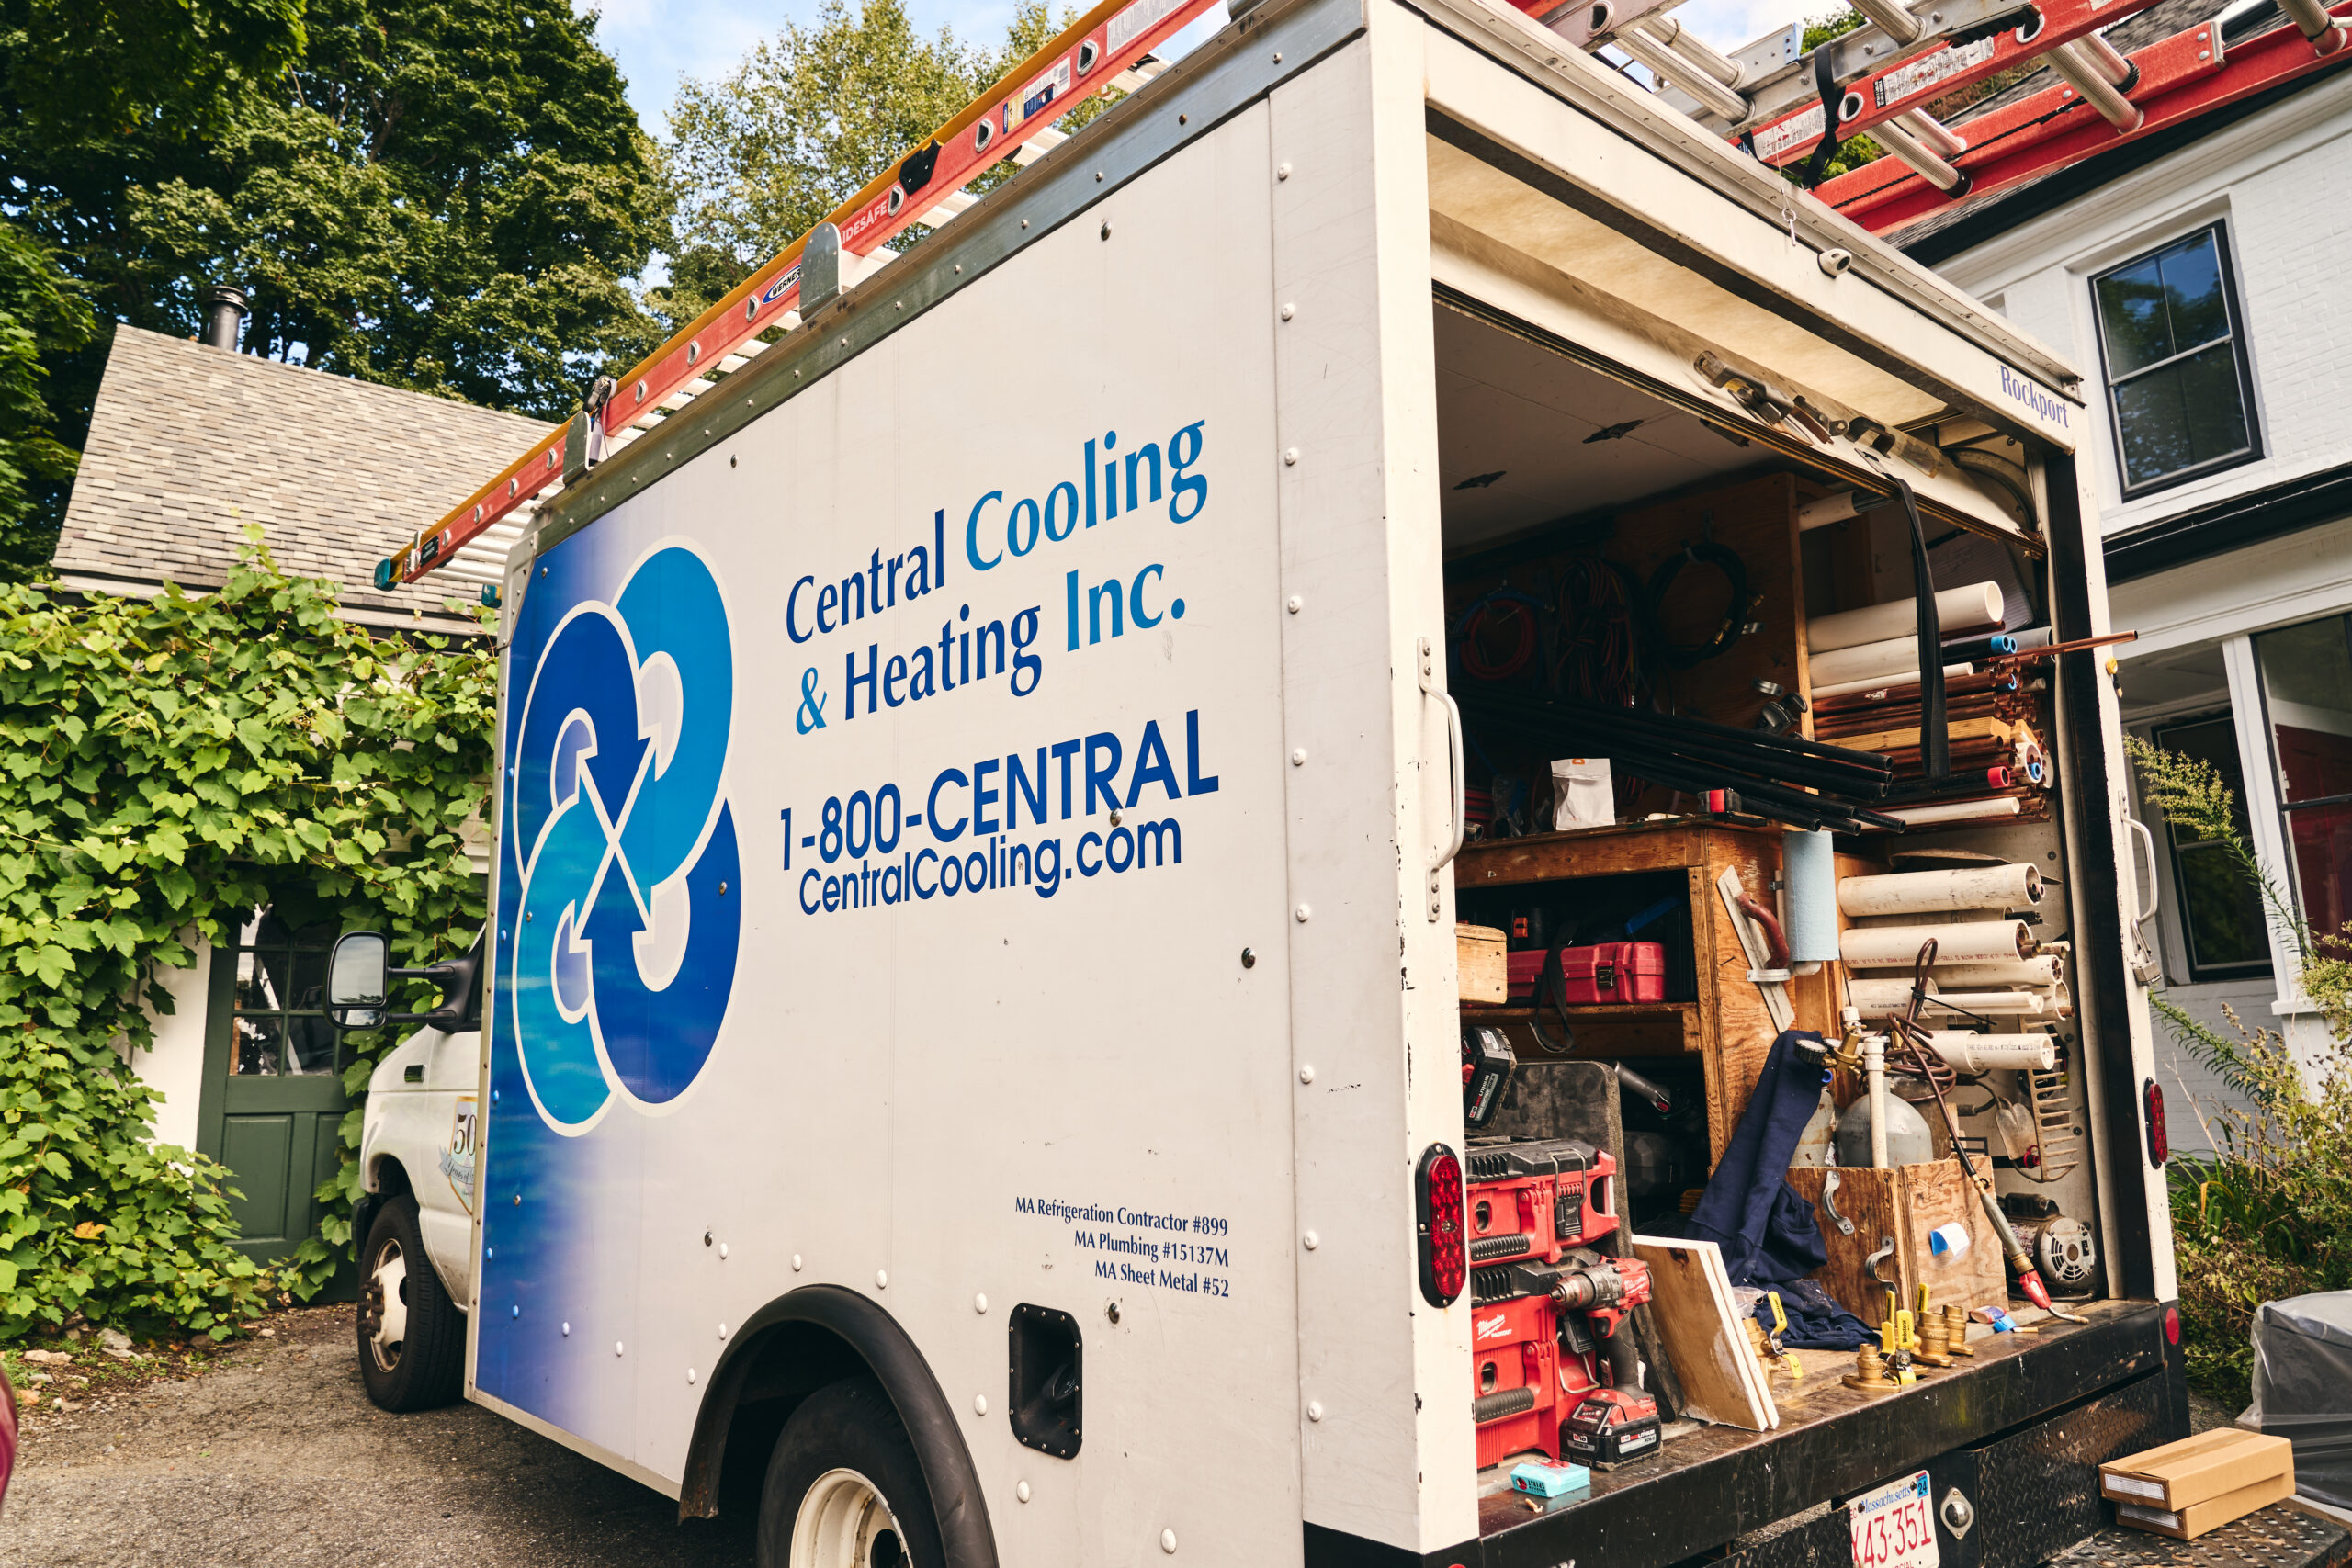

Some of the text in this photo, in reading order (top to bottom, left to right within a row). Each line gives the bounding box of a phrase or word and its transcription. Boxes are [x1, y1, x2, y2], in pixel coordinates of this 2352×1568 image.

[842, 199, 888, 244] IDESAFE
[772, 268, 801, 296] WERNER
[2000, 365, 2069, 428] Rockport
[786, 418, 1209, 643] Central Cooling
[796, 563, 1186, 735] & Heating Inc.
[780, 708, 1220, 871] 1-800-CENTRAL
[799, 818, 1182, 916] CentralCooling.com
[454, 1113, 477, 1156] 50
[1015, 1196, 1228, 1236] MA Refrigeration Contractor #899
[1074, 1230, 1229, 1268] MA Plumbing #15137M
[1094, 1260, 1229, 1297] MA Sheet Metal #52
[1860, 1485, 1911, 1513] Massachusetts
[1917, 1480, 1928, 1495] 24
